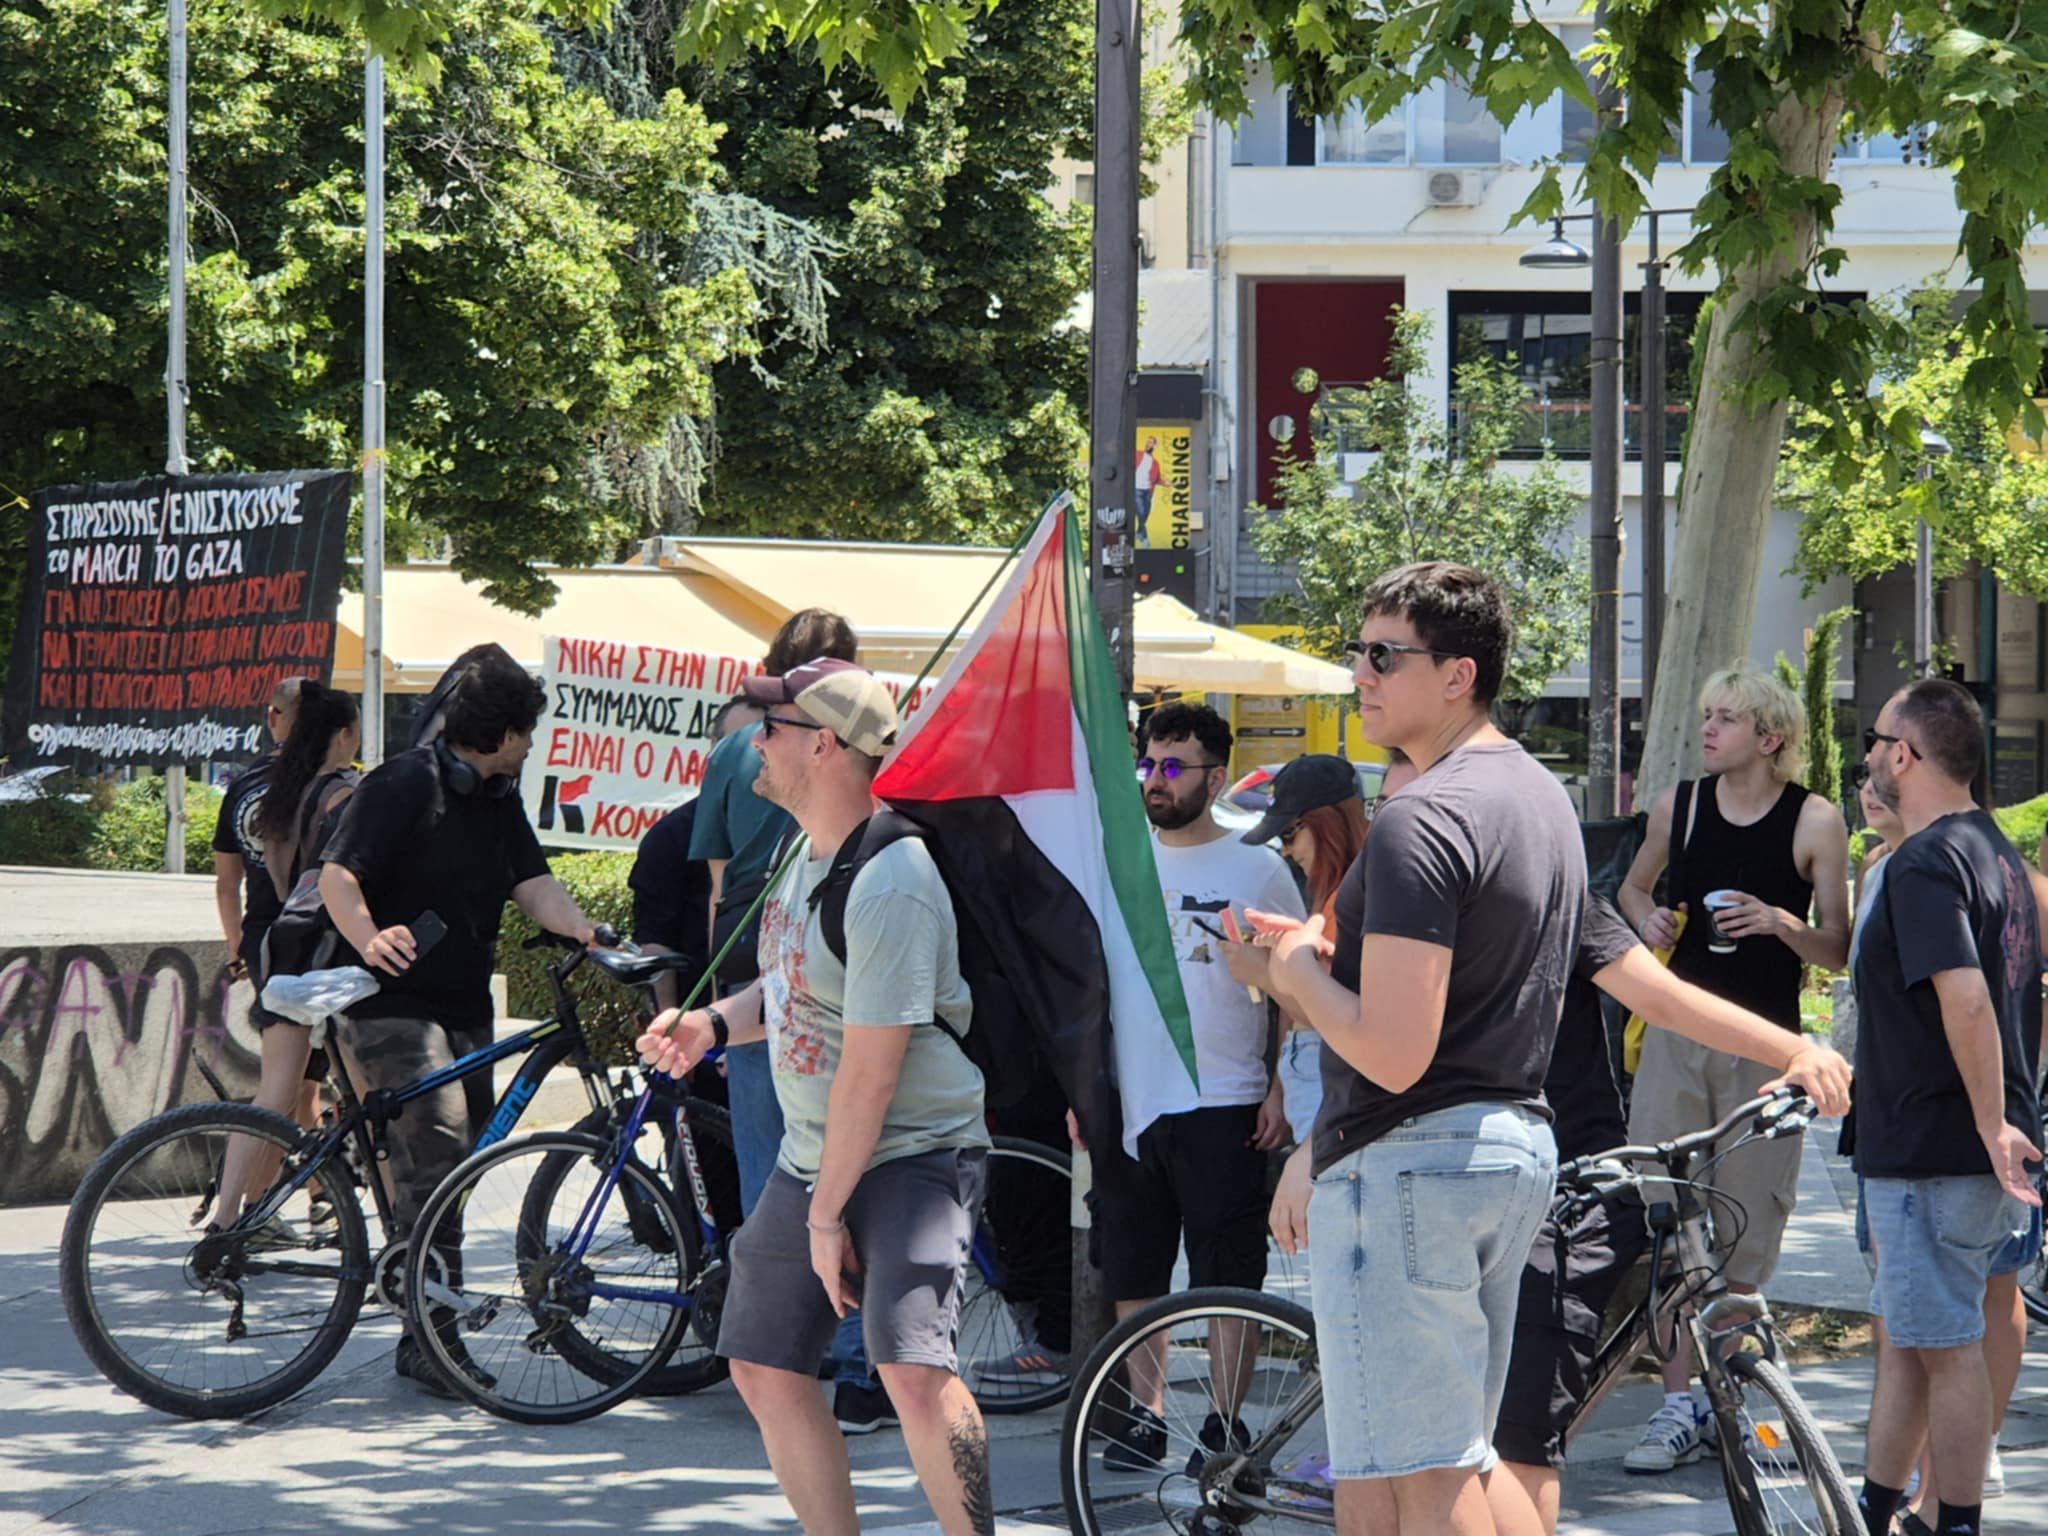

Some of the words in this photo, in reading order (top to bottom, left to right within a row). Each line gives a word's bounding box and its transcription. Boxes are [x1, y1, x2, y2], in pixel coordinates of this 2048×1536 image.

[1171, 436, 1190, 550] CHARGING
[71, 542, 141, 584] MARCH
[154, 544, 180, 583] TO
[185, 539, 243, 581] GAZA
[164, 588, 180, 626] Ο
[43, 631, 71, 669] ΝΑ
[258, 621, 330, 661] ΚΑΤΟΧΗ
[558, 637, 626, 680] ΝΙΚΗ
[632, 645, 707, 690] ΣΤΗΝ
[40, 672, 71, 709] ΚΑΙ
[553, 683, 683, 736] ΣΥΜΜΑΧΟΣ
[547, 727, 625, 775] ΕΙΝΑΙ
[633, 741, 655, 778] Ο
